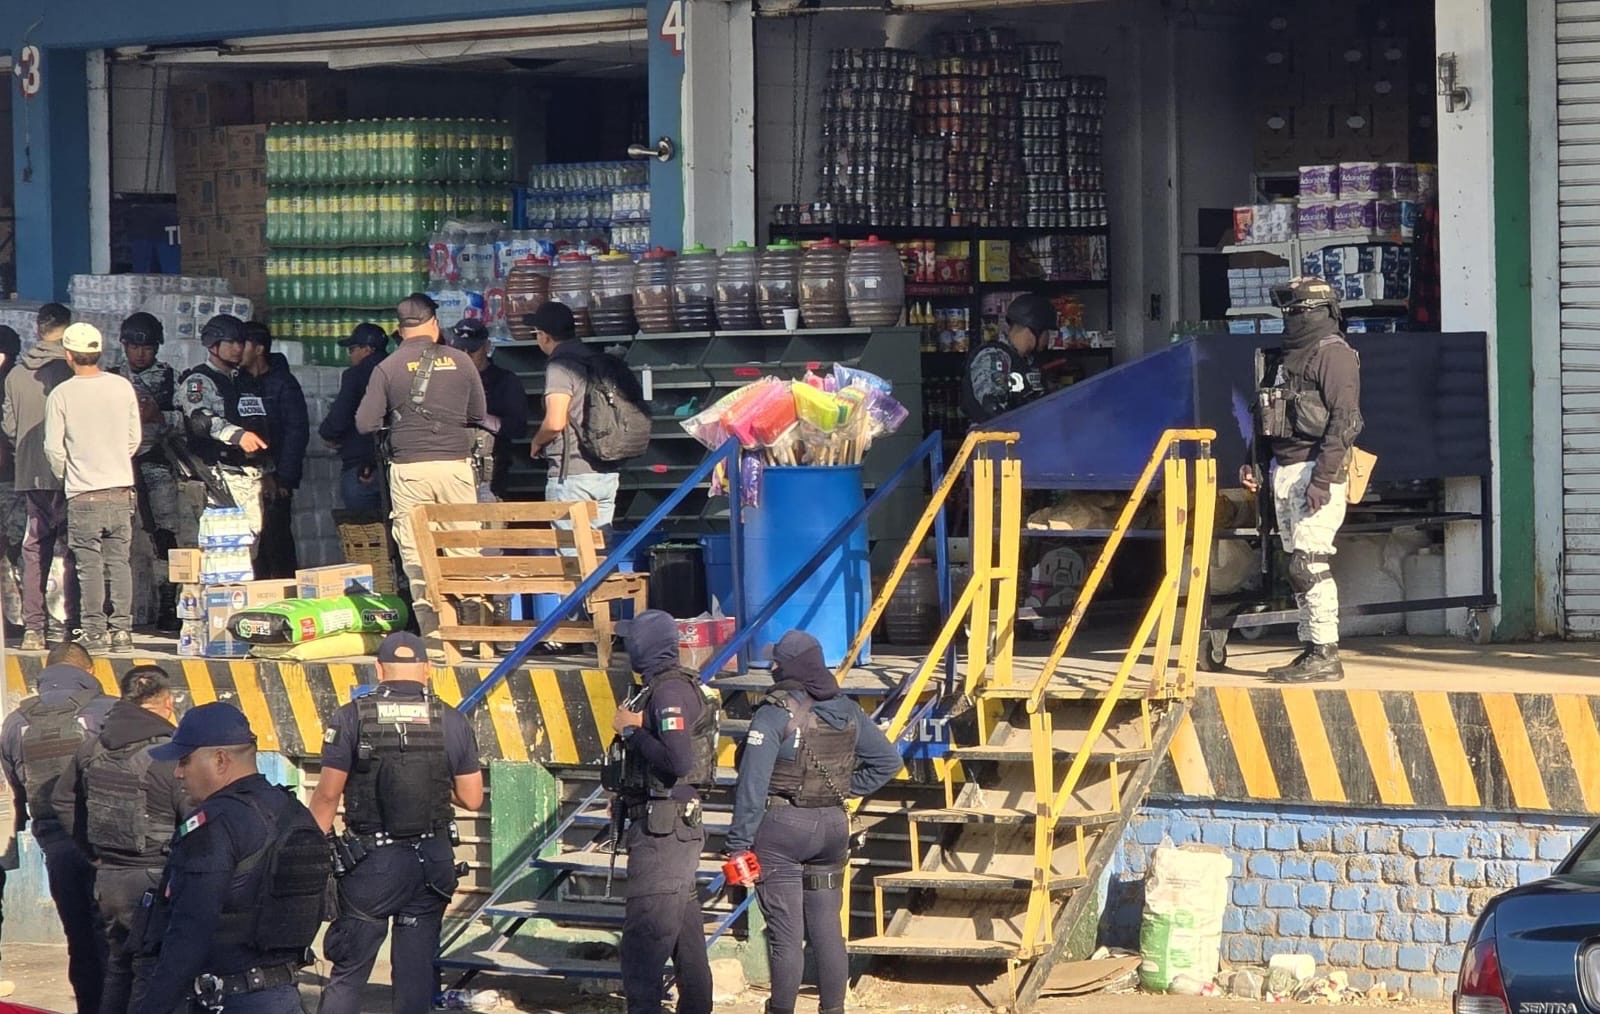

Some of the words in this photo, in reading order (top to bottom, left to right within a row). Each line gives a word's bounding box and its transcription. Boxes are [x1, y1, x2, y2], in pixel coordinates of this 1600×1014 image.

[662, 0, 684, 51] 4
[21, 46, 40, 95] 3
[1519, 1002, 1577, 1014] SENTRA
